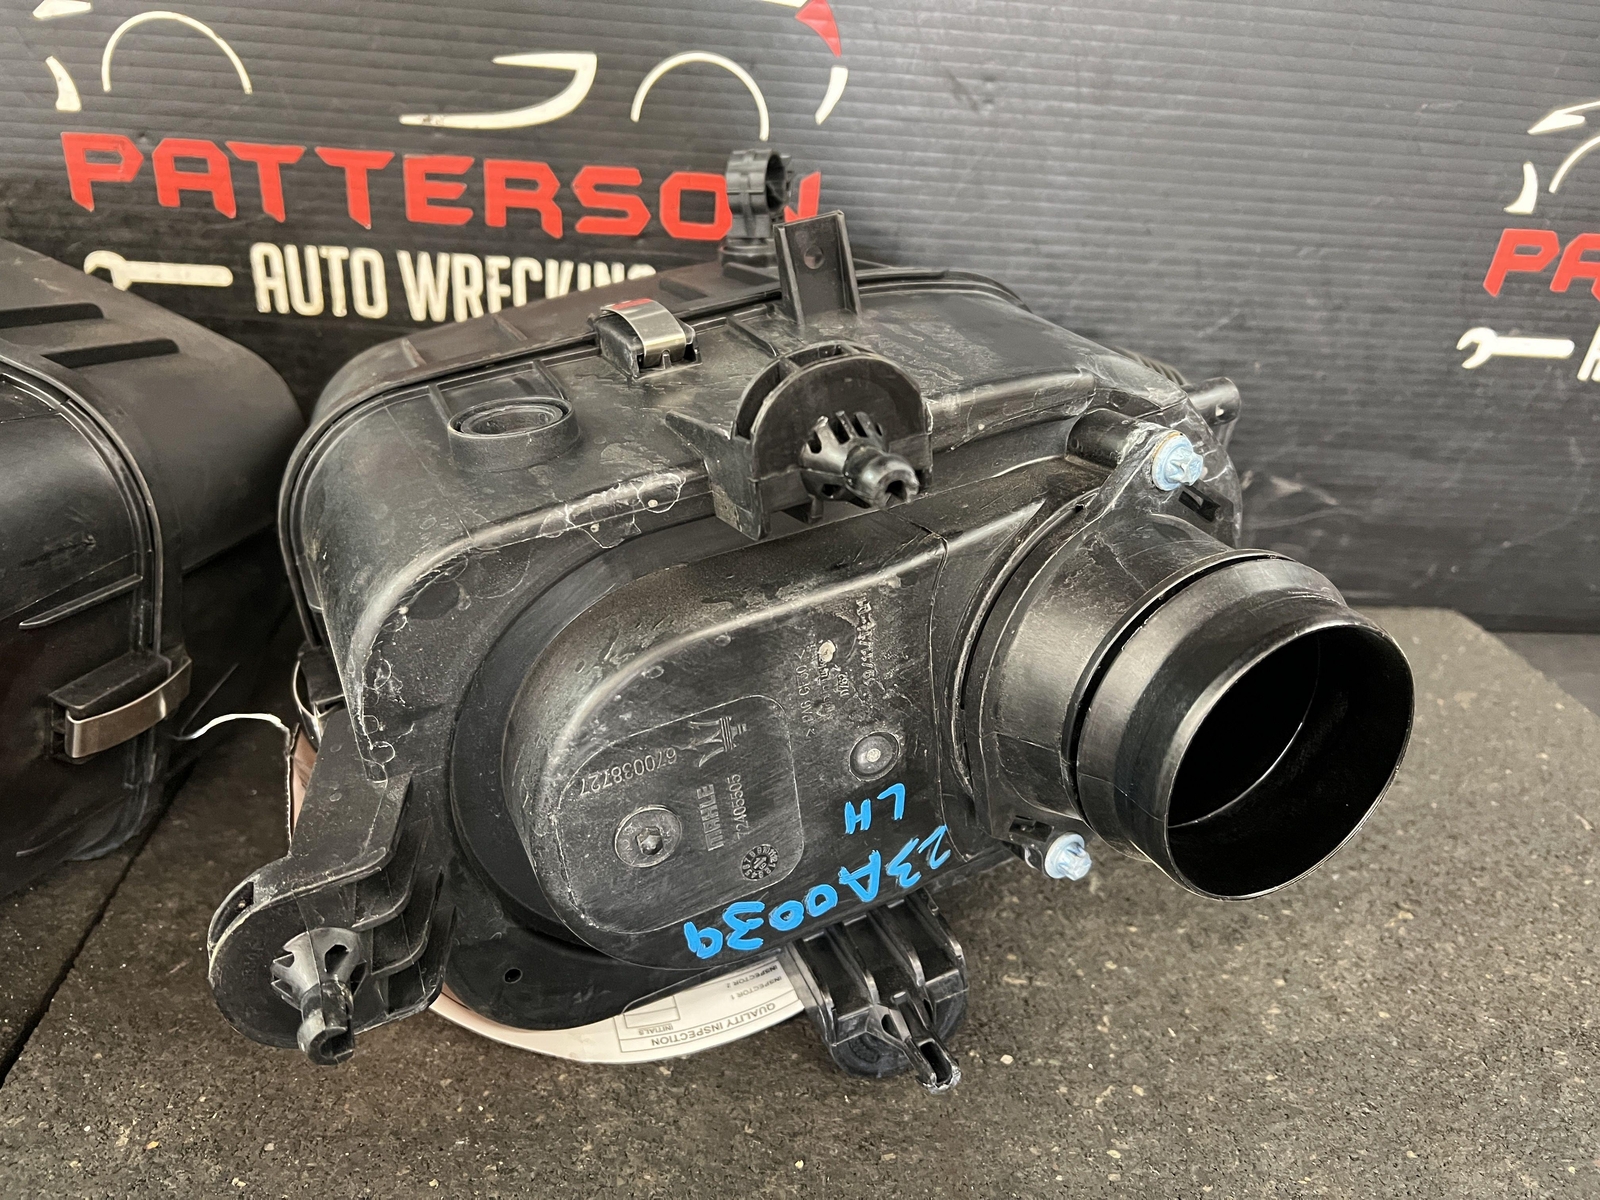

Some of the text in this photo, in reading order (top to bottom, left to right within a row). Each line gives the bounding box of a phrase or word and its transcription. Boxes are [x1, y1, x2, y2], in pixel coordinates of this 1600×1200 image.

[250, 242, 389, 319] AUTO
[579, 747, 678, 796] 670038727
[696, 783, 725, 852] MAHLE
[727, 773, 751, 841] 72405505
[844, 783, 905, 834] LH
[683, 824, 951, 959] 23A0039
[734, 964, 778, 987] INSPECTOR
[738, 975, 782, 999] INSPECTOR
[638, 1023, 674, 1036] INITIALS
[651, 1002, 776, 1046] QUALITY INSPECTION
